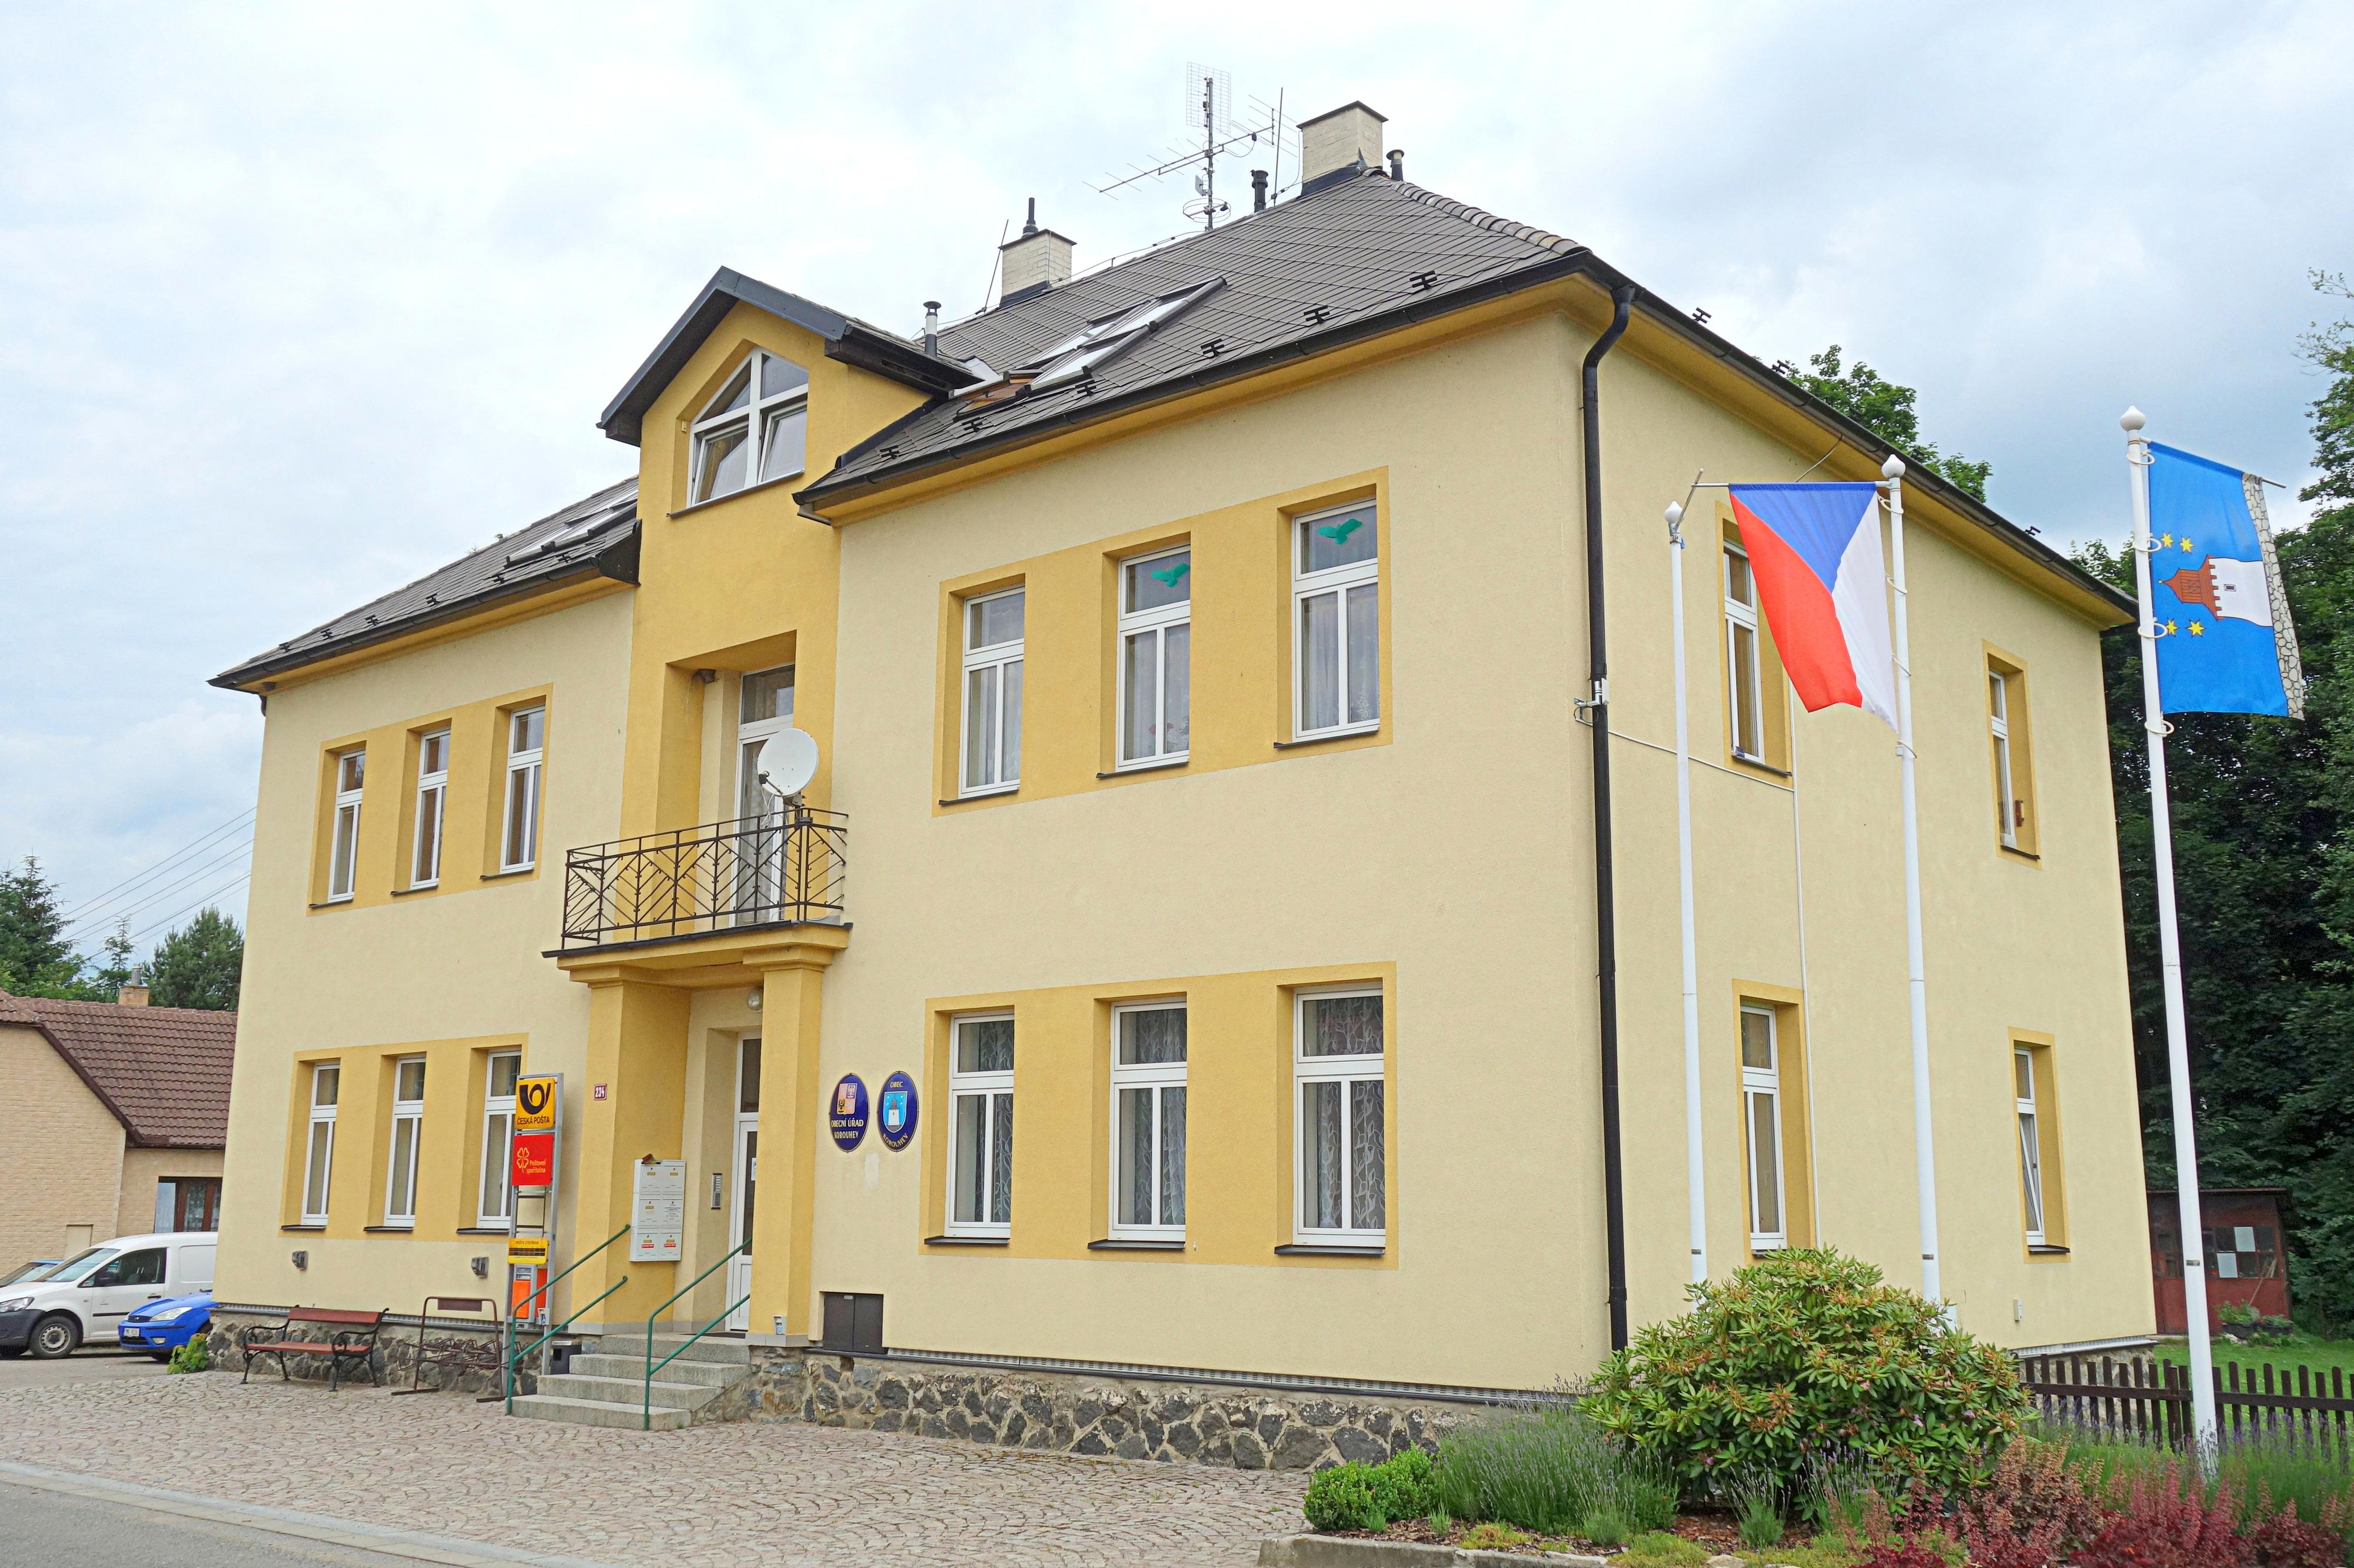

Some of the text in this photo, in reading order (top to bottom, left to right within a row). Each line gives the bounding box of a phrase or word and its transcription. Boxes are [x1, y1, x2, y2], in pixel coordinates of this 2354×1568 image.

[595, 1087, 605, 1098] 234
[517, 1115, 550, 1125] ČESKÁ POŠTA
[830, 1117, 864, 1127] OBECNÍ ÚŘAD
[834, 1130, 859, 1139] KOROUHEV
[883, 1133, 908, 1147] KOROUHEV
